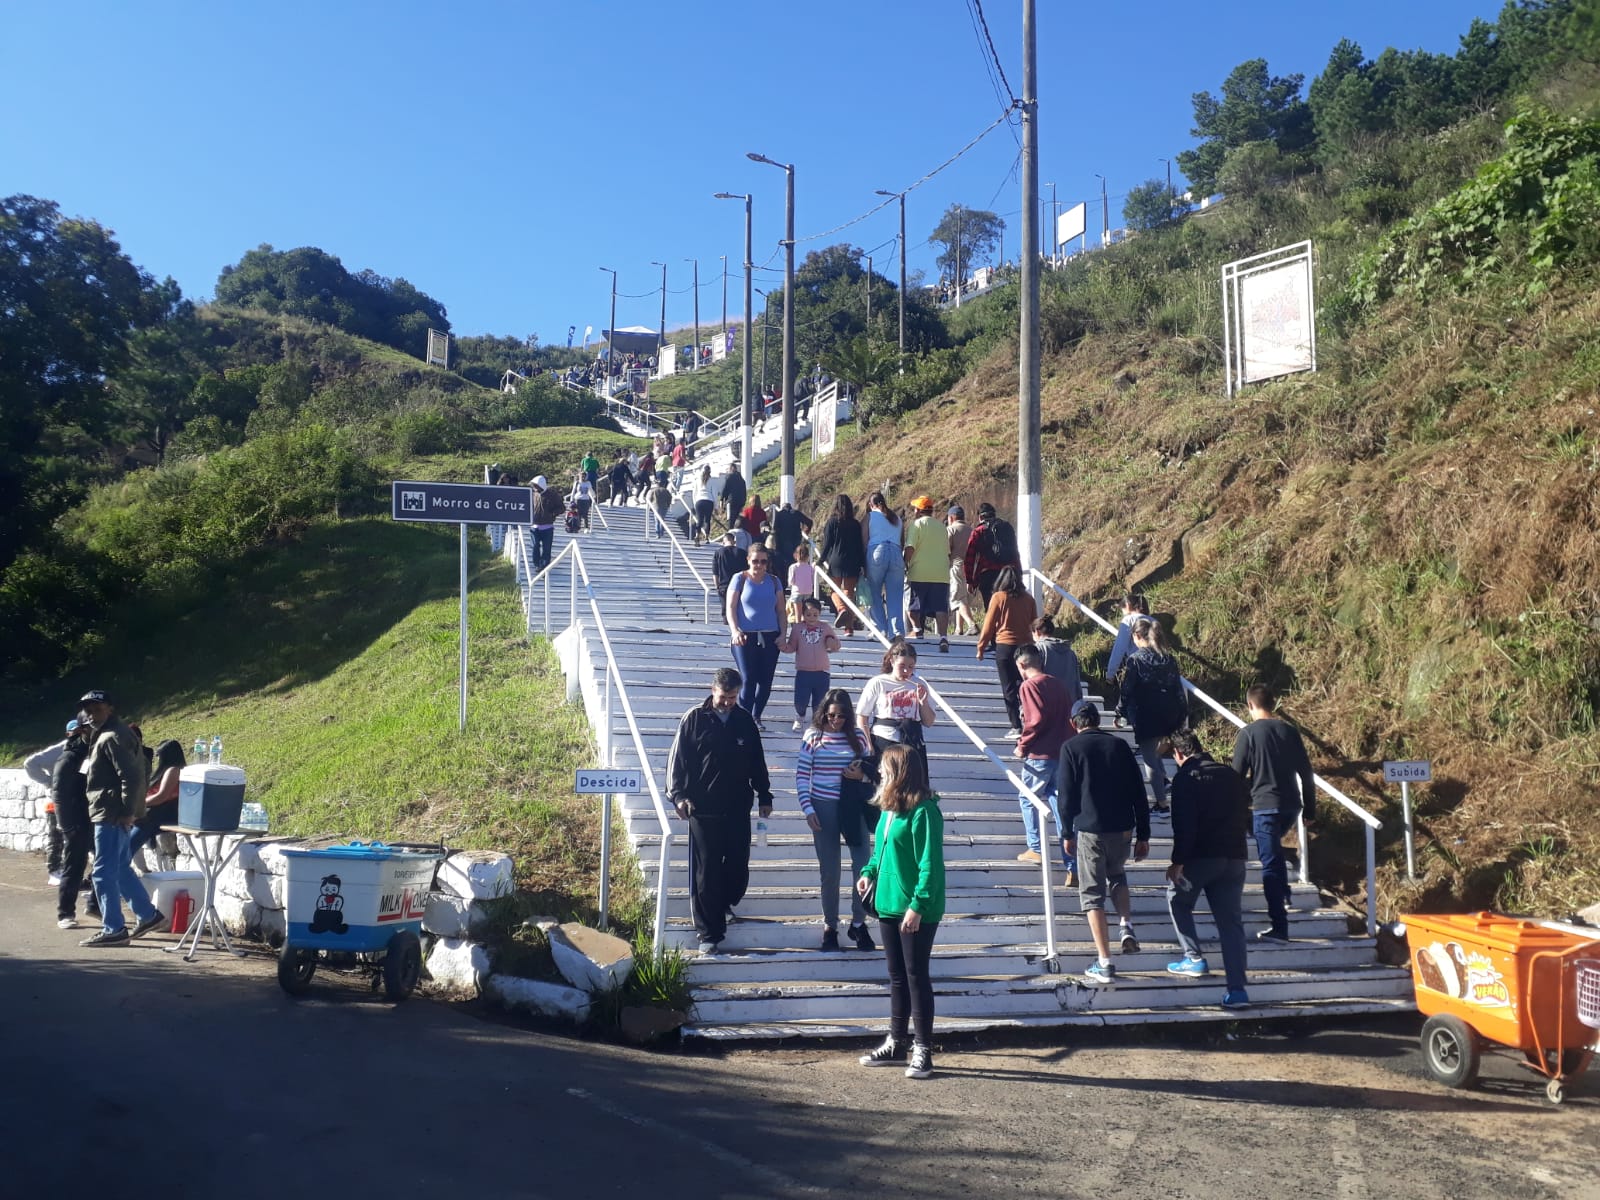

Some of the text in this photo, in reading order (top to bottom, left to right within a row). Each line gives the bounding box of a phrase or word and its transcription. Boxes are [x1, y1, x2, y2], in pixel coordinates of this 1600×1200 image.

[432, 496, 526, 511] Morro da Cruz
[1390, 767, 1426, 777] Subida
[580, 776, 636, 787] Descida
[379, 893, 402, 913] MILK
